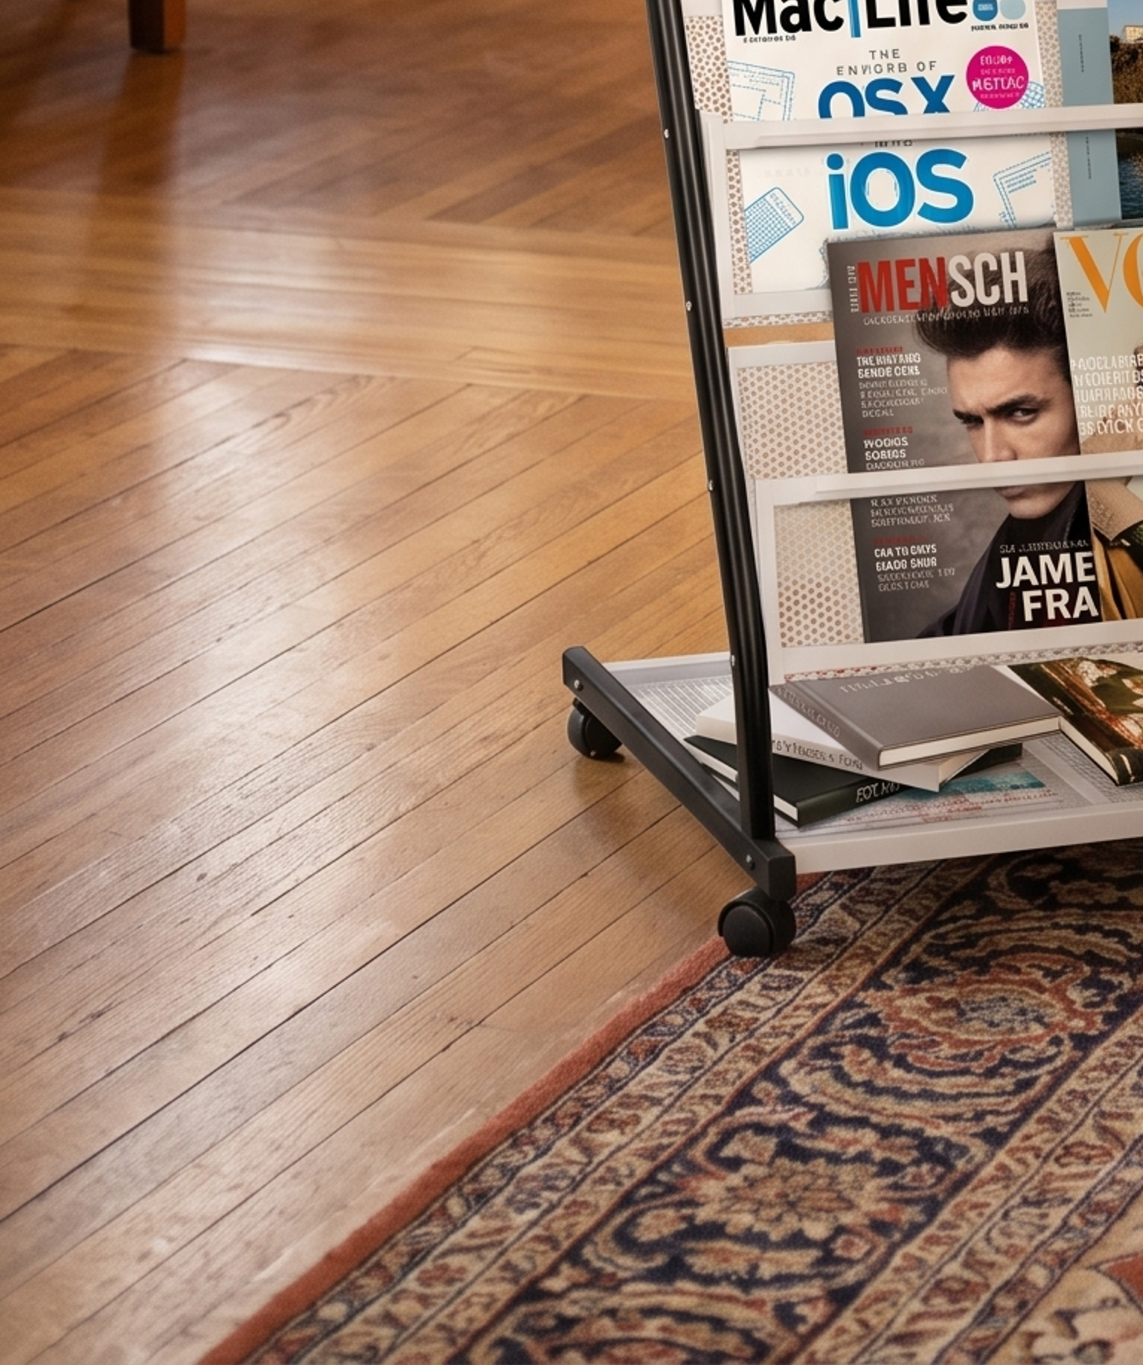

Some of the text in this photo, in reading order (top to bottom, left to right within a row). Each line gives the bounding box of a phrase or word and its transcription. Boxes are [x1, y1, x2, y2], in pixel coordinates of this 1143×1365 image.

[916, 60, 937, 73] OF
[826, 148, 975, 230] iOS
[857, 251, 1028, 313] MENSCH
[995, 551, 1096, 588] JAME
[1022, 586, 1099, 622] FRA
